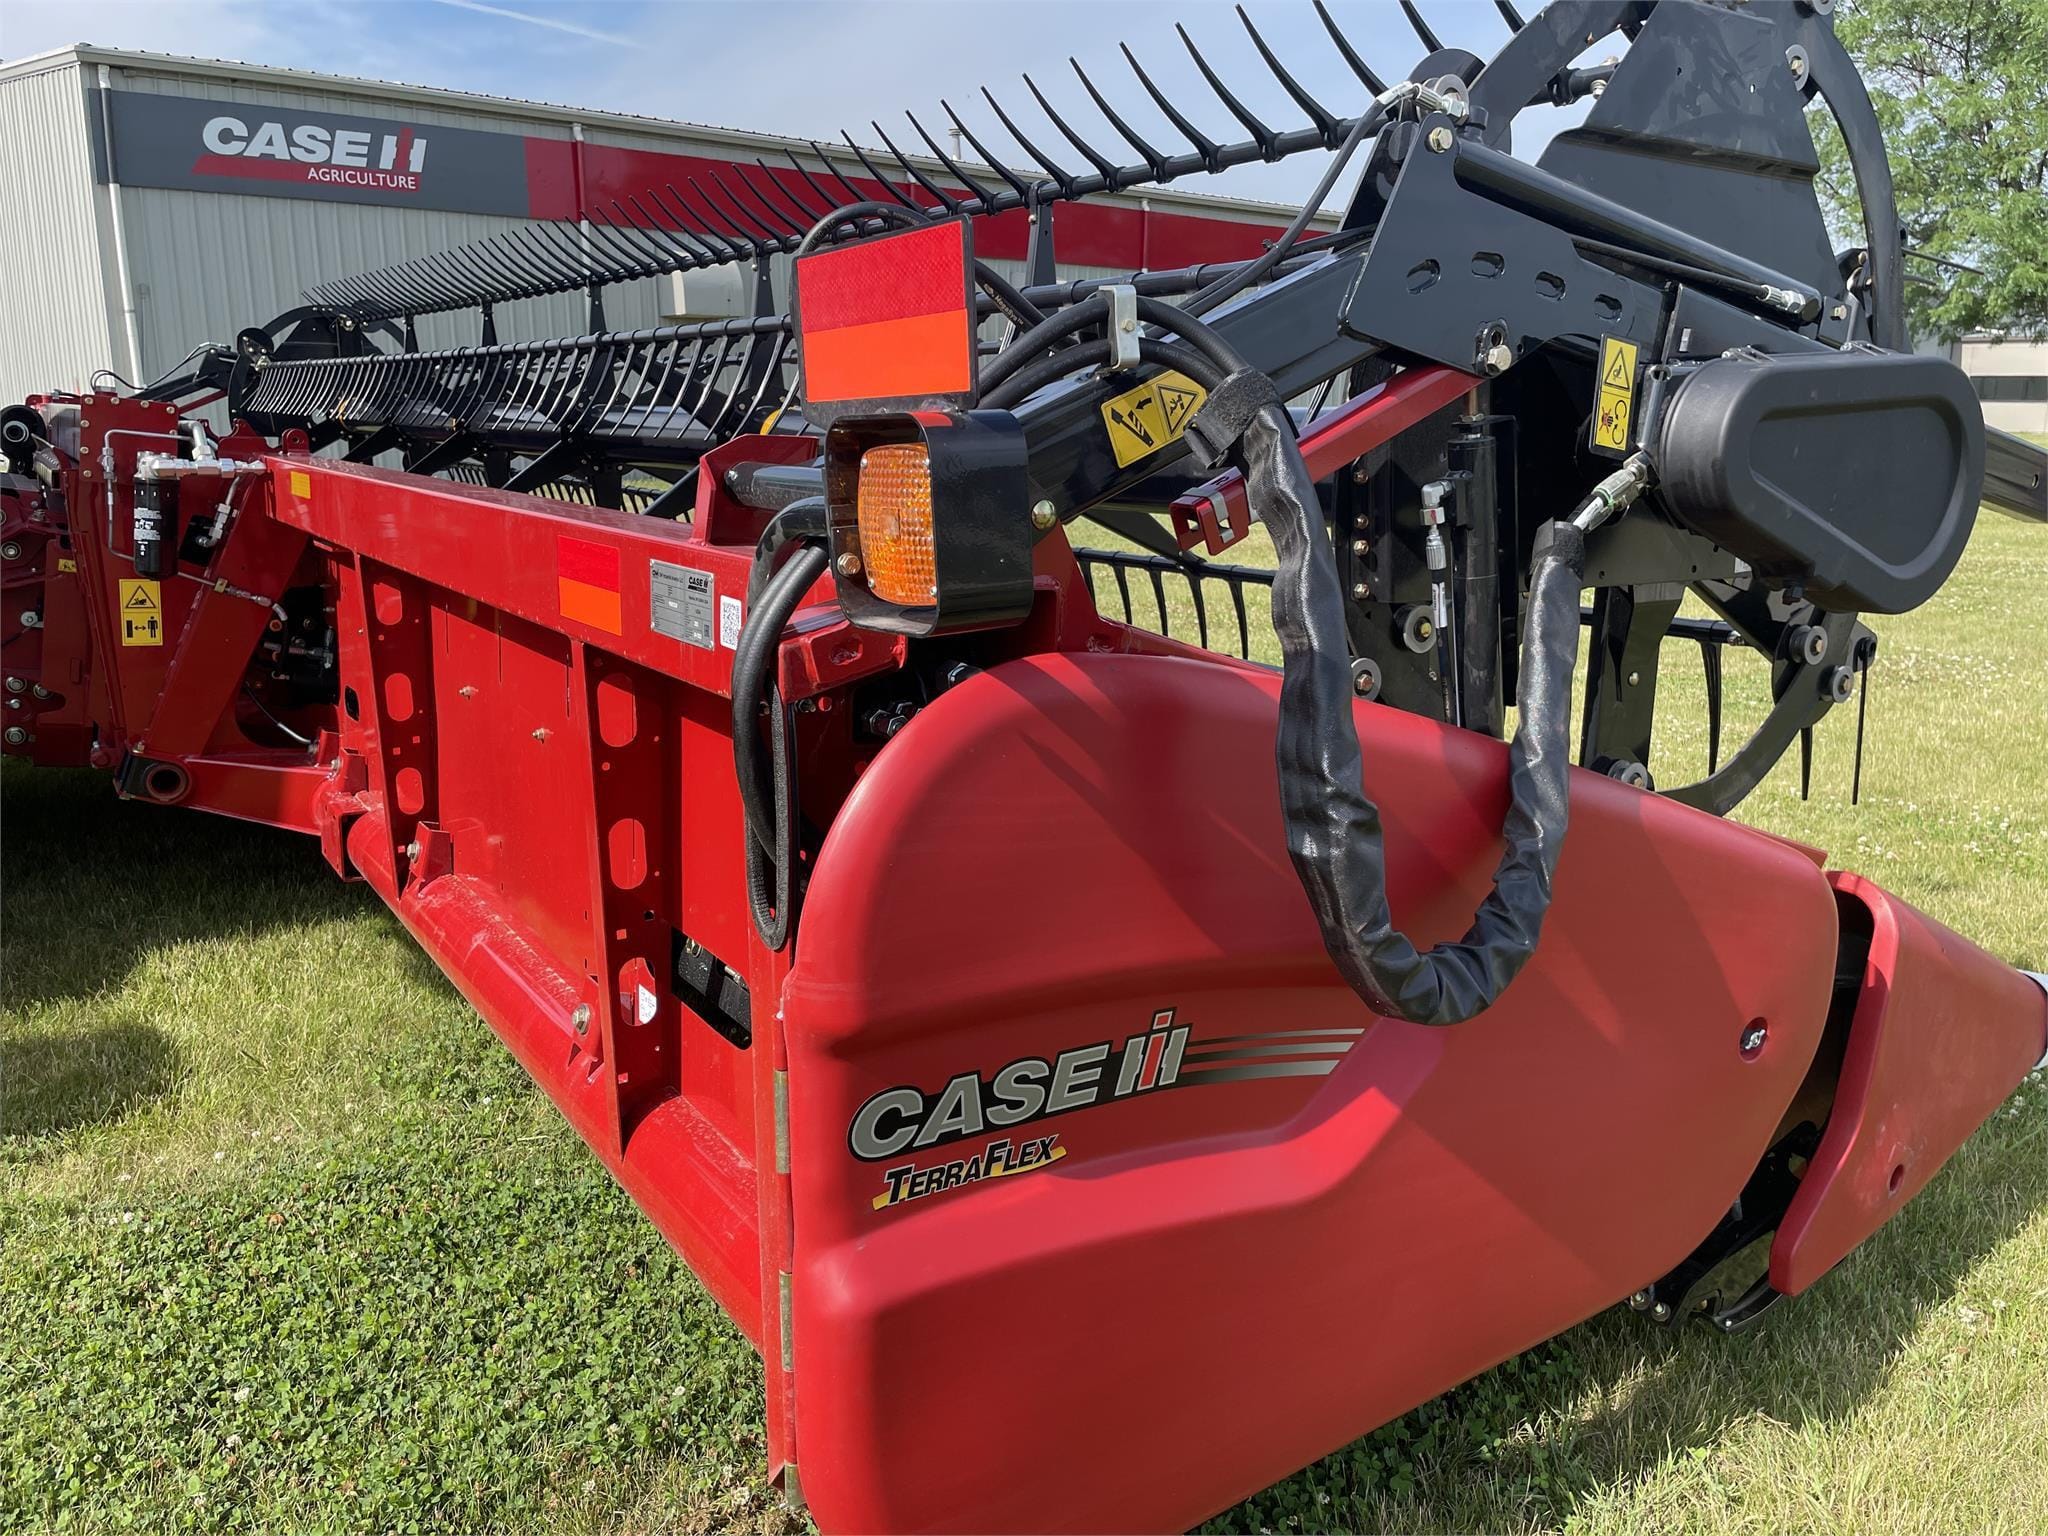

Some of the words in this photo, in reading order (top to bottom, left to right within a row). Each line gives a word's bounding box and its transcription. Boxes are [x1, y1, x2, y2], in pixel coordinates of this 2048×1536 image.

[202, 116, 371, 168] CASE
[307, 167, 417, 190] AGRICULTURE
[850, 1043, 1111, 1160] CASE
